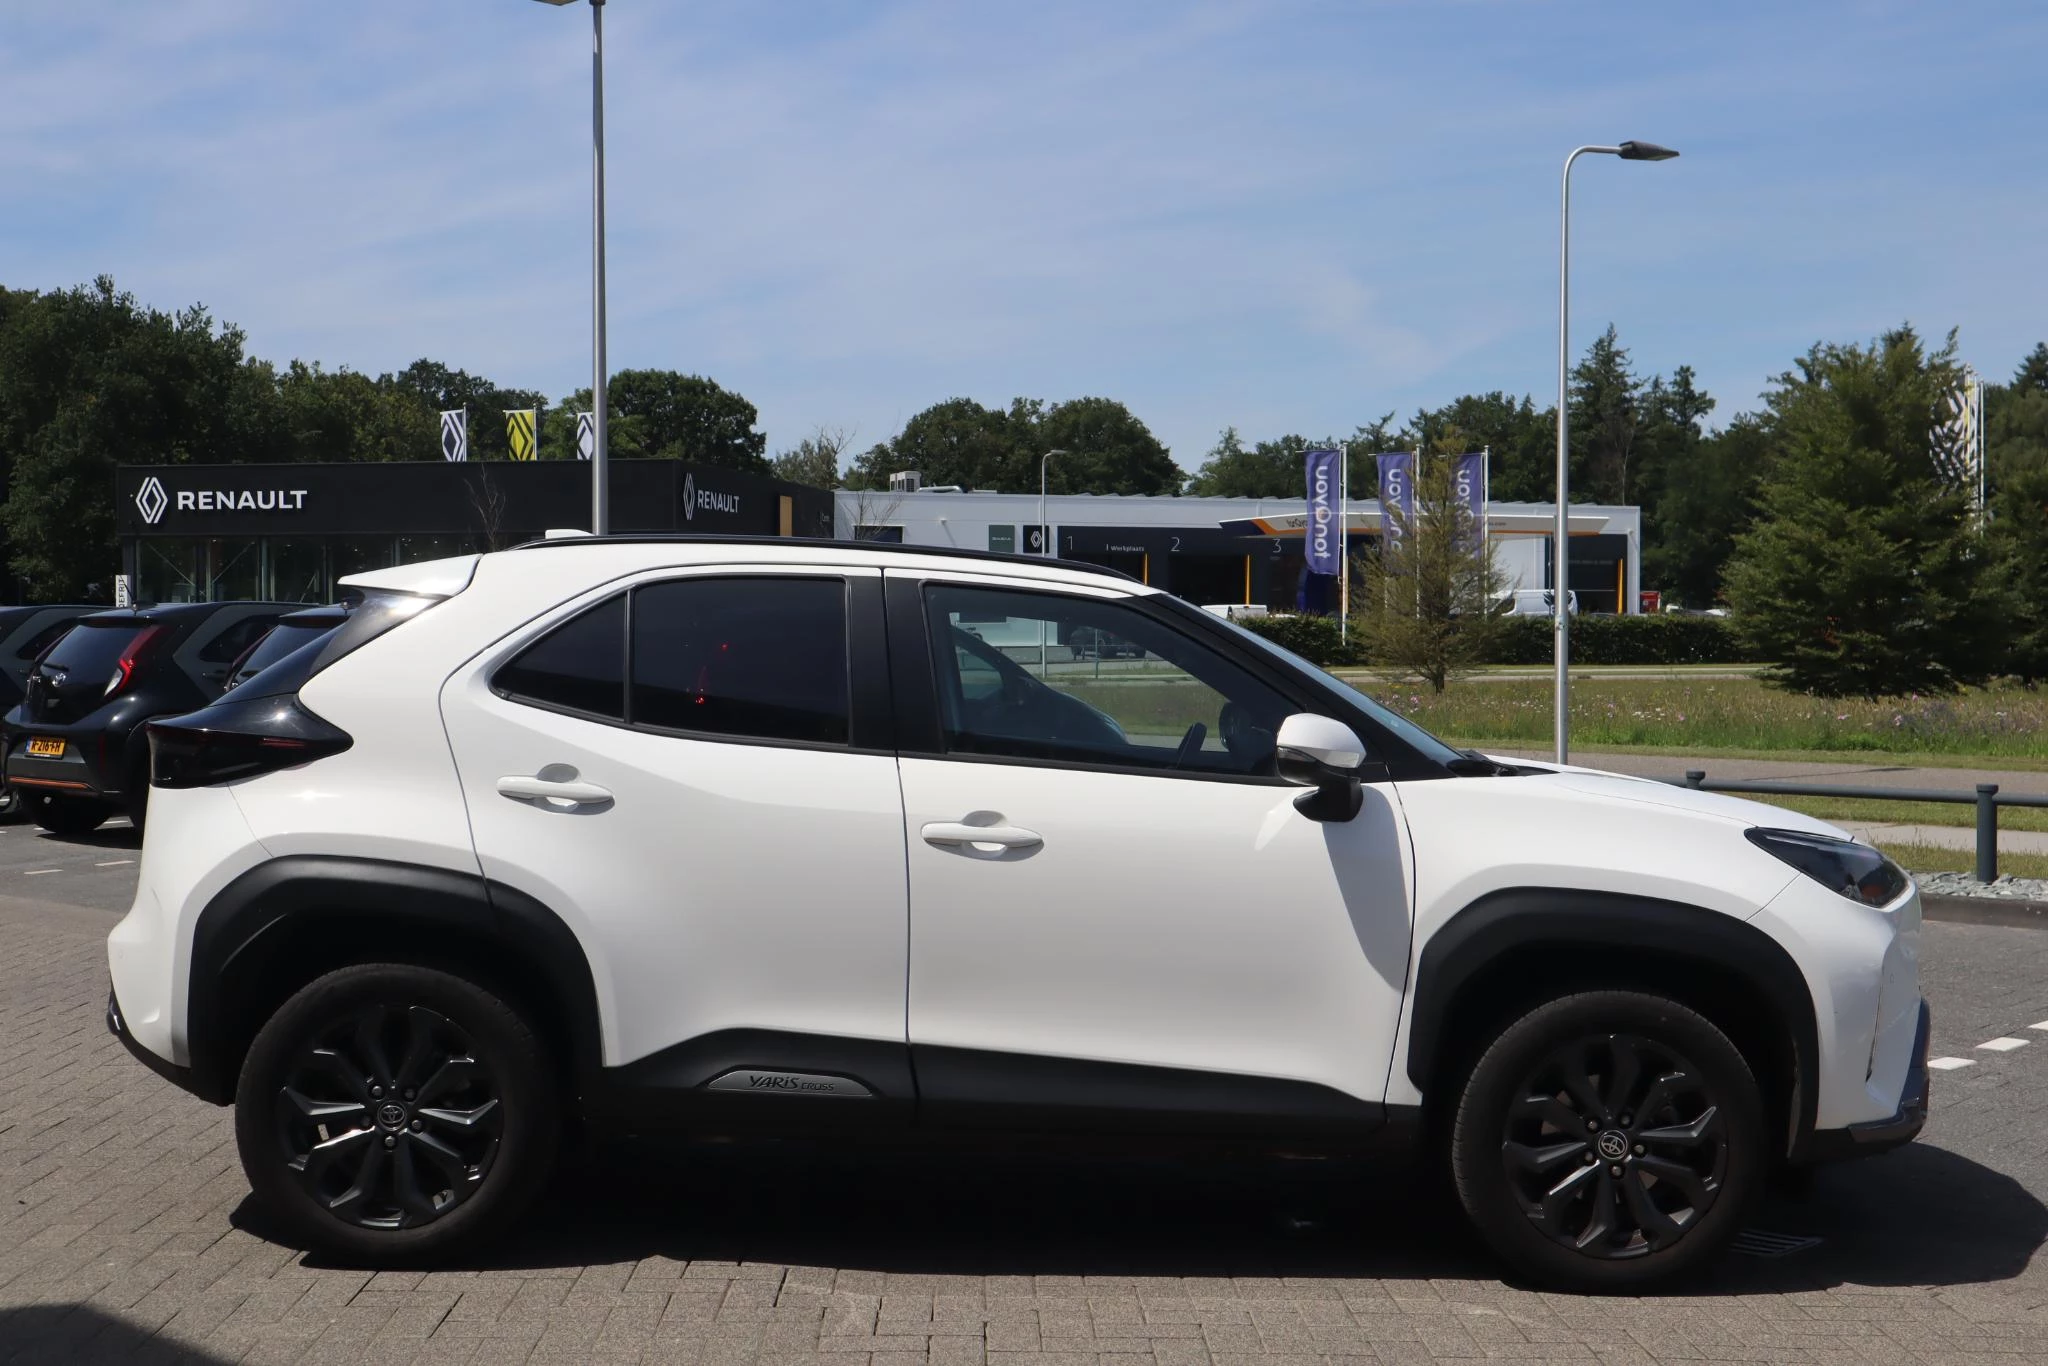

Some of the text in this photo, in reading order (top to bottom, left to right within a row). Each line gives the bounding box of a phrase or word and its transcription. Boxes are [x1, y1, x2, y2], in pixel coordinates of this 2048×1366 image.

[177, 490, 308, 510] RENAULT
[697, 489, 740, 513] RENAULT
[1067, 535, 1073, 550] 1
[1170, 536, 1181, 552] 2
[1272, 538, 1282, 553] 3
[801, 1082, 835, 1091] CROSS
